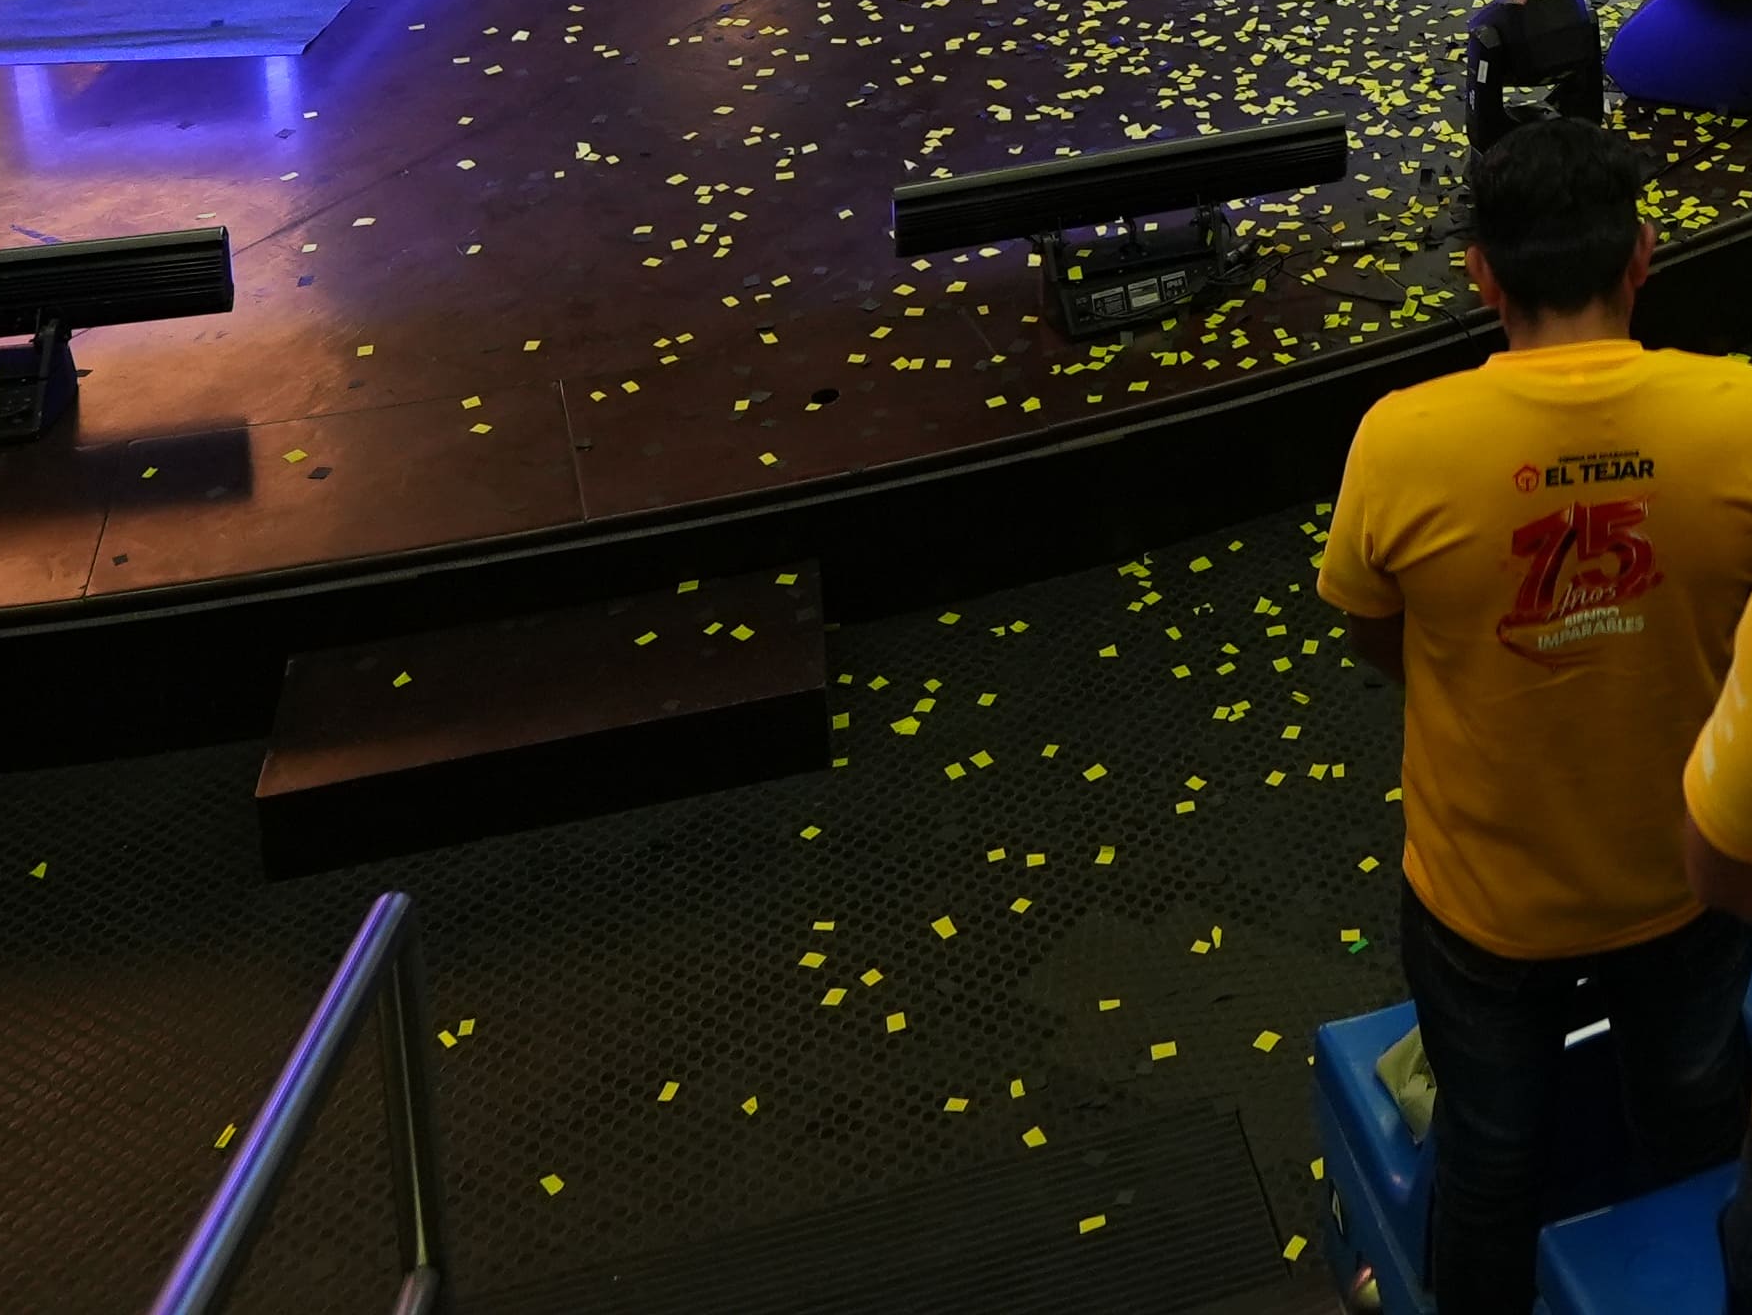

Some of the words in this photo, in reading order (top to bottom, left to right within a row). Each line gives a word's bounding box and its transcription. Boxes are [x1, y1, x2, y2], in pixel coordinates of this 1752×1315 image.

[1545, 466, 1575, 488] EL
[1579, 458, 1655, 484] TEJAR
[1511, 498, 1657, 617] 75
[1564, 605, 1620, 627] SIENDO
[1537, 615, 1646, 651] IMPARABLES
